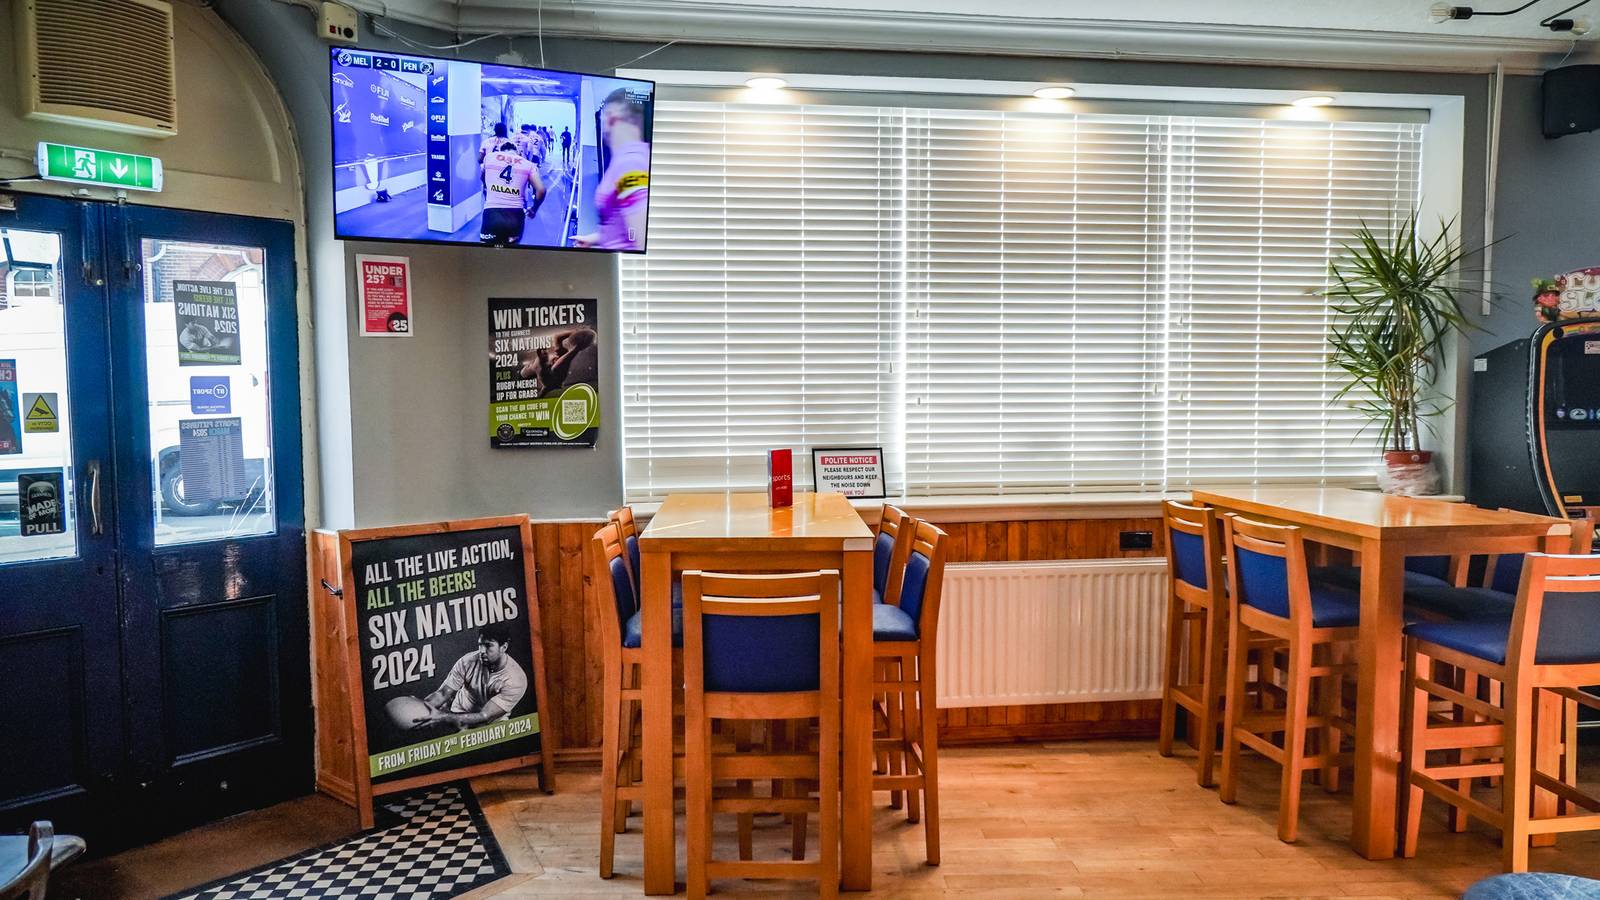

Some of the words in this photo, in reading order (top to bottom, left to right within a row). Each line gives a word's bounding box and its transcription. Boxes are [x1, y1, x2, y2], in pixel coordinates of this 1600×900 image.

[353, 57, 368, 66] MEL
[376, 59, 382, 67] 2
[391, 60, 396, 68] 0
[403, 62, 418, 71] PEN
[500, 165, 512, 183] 4
[491, 184, 520, 196] ALLAM
[365, 265, 403, 275] UNDER
[366, 275, 385, 284] 25?
[493, 308, 522, 330] WIN
[526, 304, 585, 327] TICKETS
[393, 320, 408, 331] 25
[495, 339, 512, 352] SIX
[512, 336, 551, 352] NATIONS
[495, 353, 518, 368] 2024
[496, 371, 511, 380] PLUS
[496, 393, 504, 401] UP
[506, 392, 517, 400] FOR
[518, 390, 538, 398] GRABS
[509, 412, 528, 420] CHANCE
[536, 411, 550, 421] WIN
[27, 499, 56, 512] MADE
[27, 522, 60, 534] PULL
[365, 562, 392, 585] ALL
[395, 555, 424, 579] THE
[427, 549, 458, 573] LIVE
[461, 538, 515, 567] ACTION,
[367, 586, 394, 610] ALL
[397, 579, 426, 603] THE
[429, 570, 477, 597] BEERS!
[368, 609, 410, 650] SIX
[415, 587, 519, 640] NATIONS
[372, 644, 436, 690] 2024
[378, 754, 406, 771] FROM
[408, 744, 443, 764] FRIDAY
[444, 737, 458, 753] 2ND
[460, 726, 507, 749] FEBRUARY
[509, 717, 532, 736] 2024
